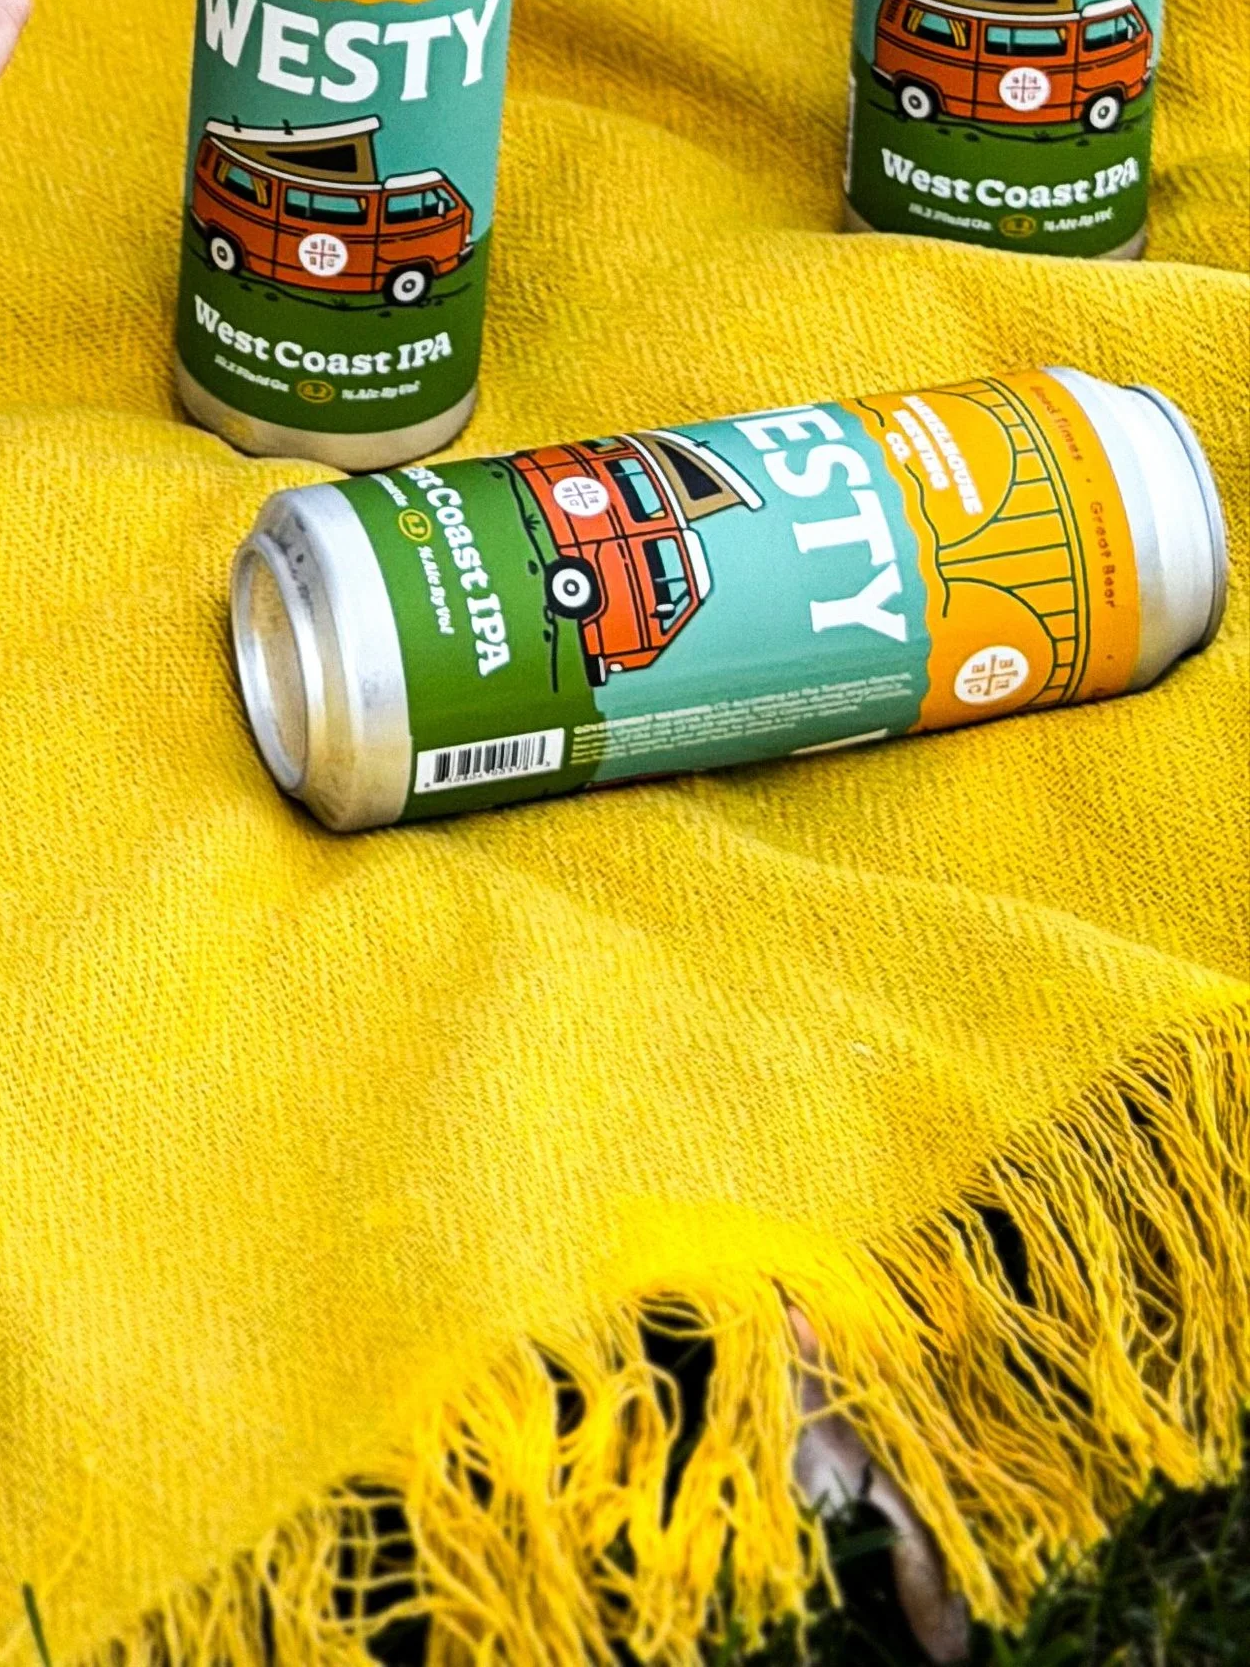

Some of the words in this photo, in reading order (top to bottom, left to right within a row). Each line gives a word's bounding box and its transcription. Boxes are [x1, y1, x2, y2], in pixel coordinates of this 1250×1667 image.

[881, 148, 971, 204] West
[975, 178, 1091, 209] Coast
[1093, 157, 1140, 198] IPA
[194, 294, 270, 361] West
[275, 341, 392, 376] Coast
[397, 331, 452, 371] IPA
[734, 406, 908, 643] ESTY
[1089, 501, 1112, 558] Great
[1102, 564, 1116, 608] Beer
[426, 487, 489, 591] Coast
[466, 593, 510, 677] IPA
